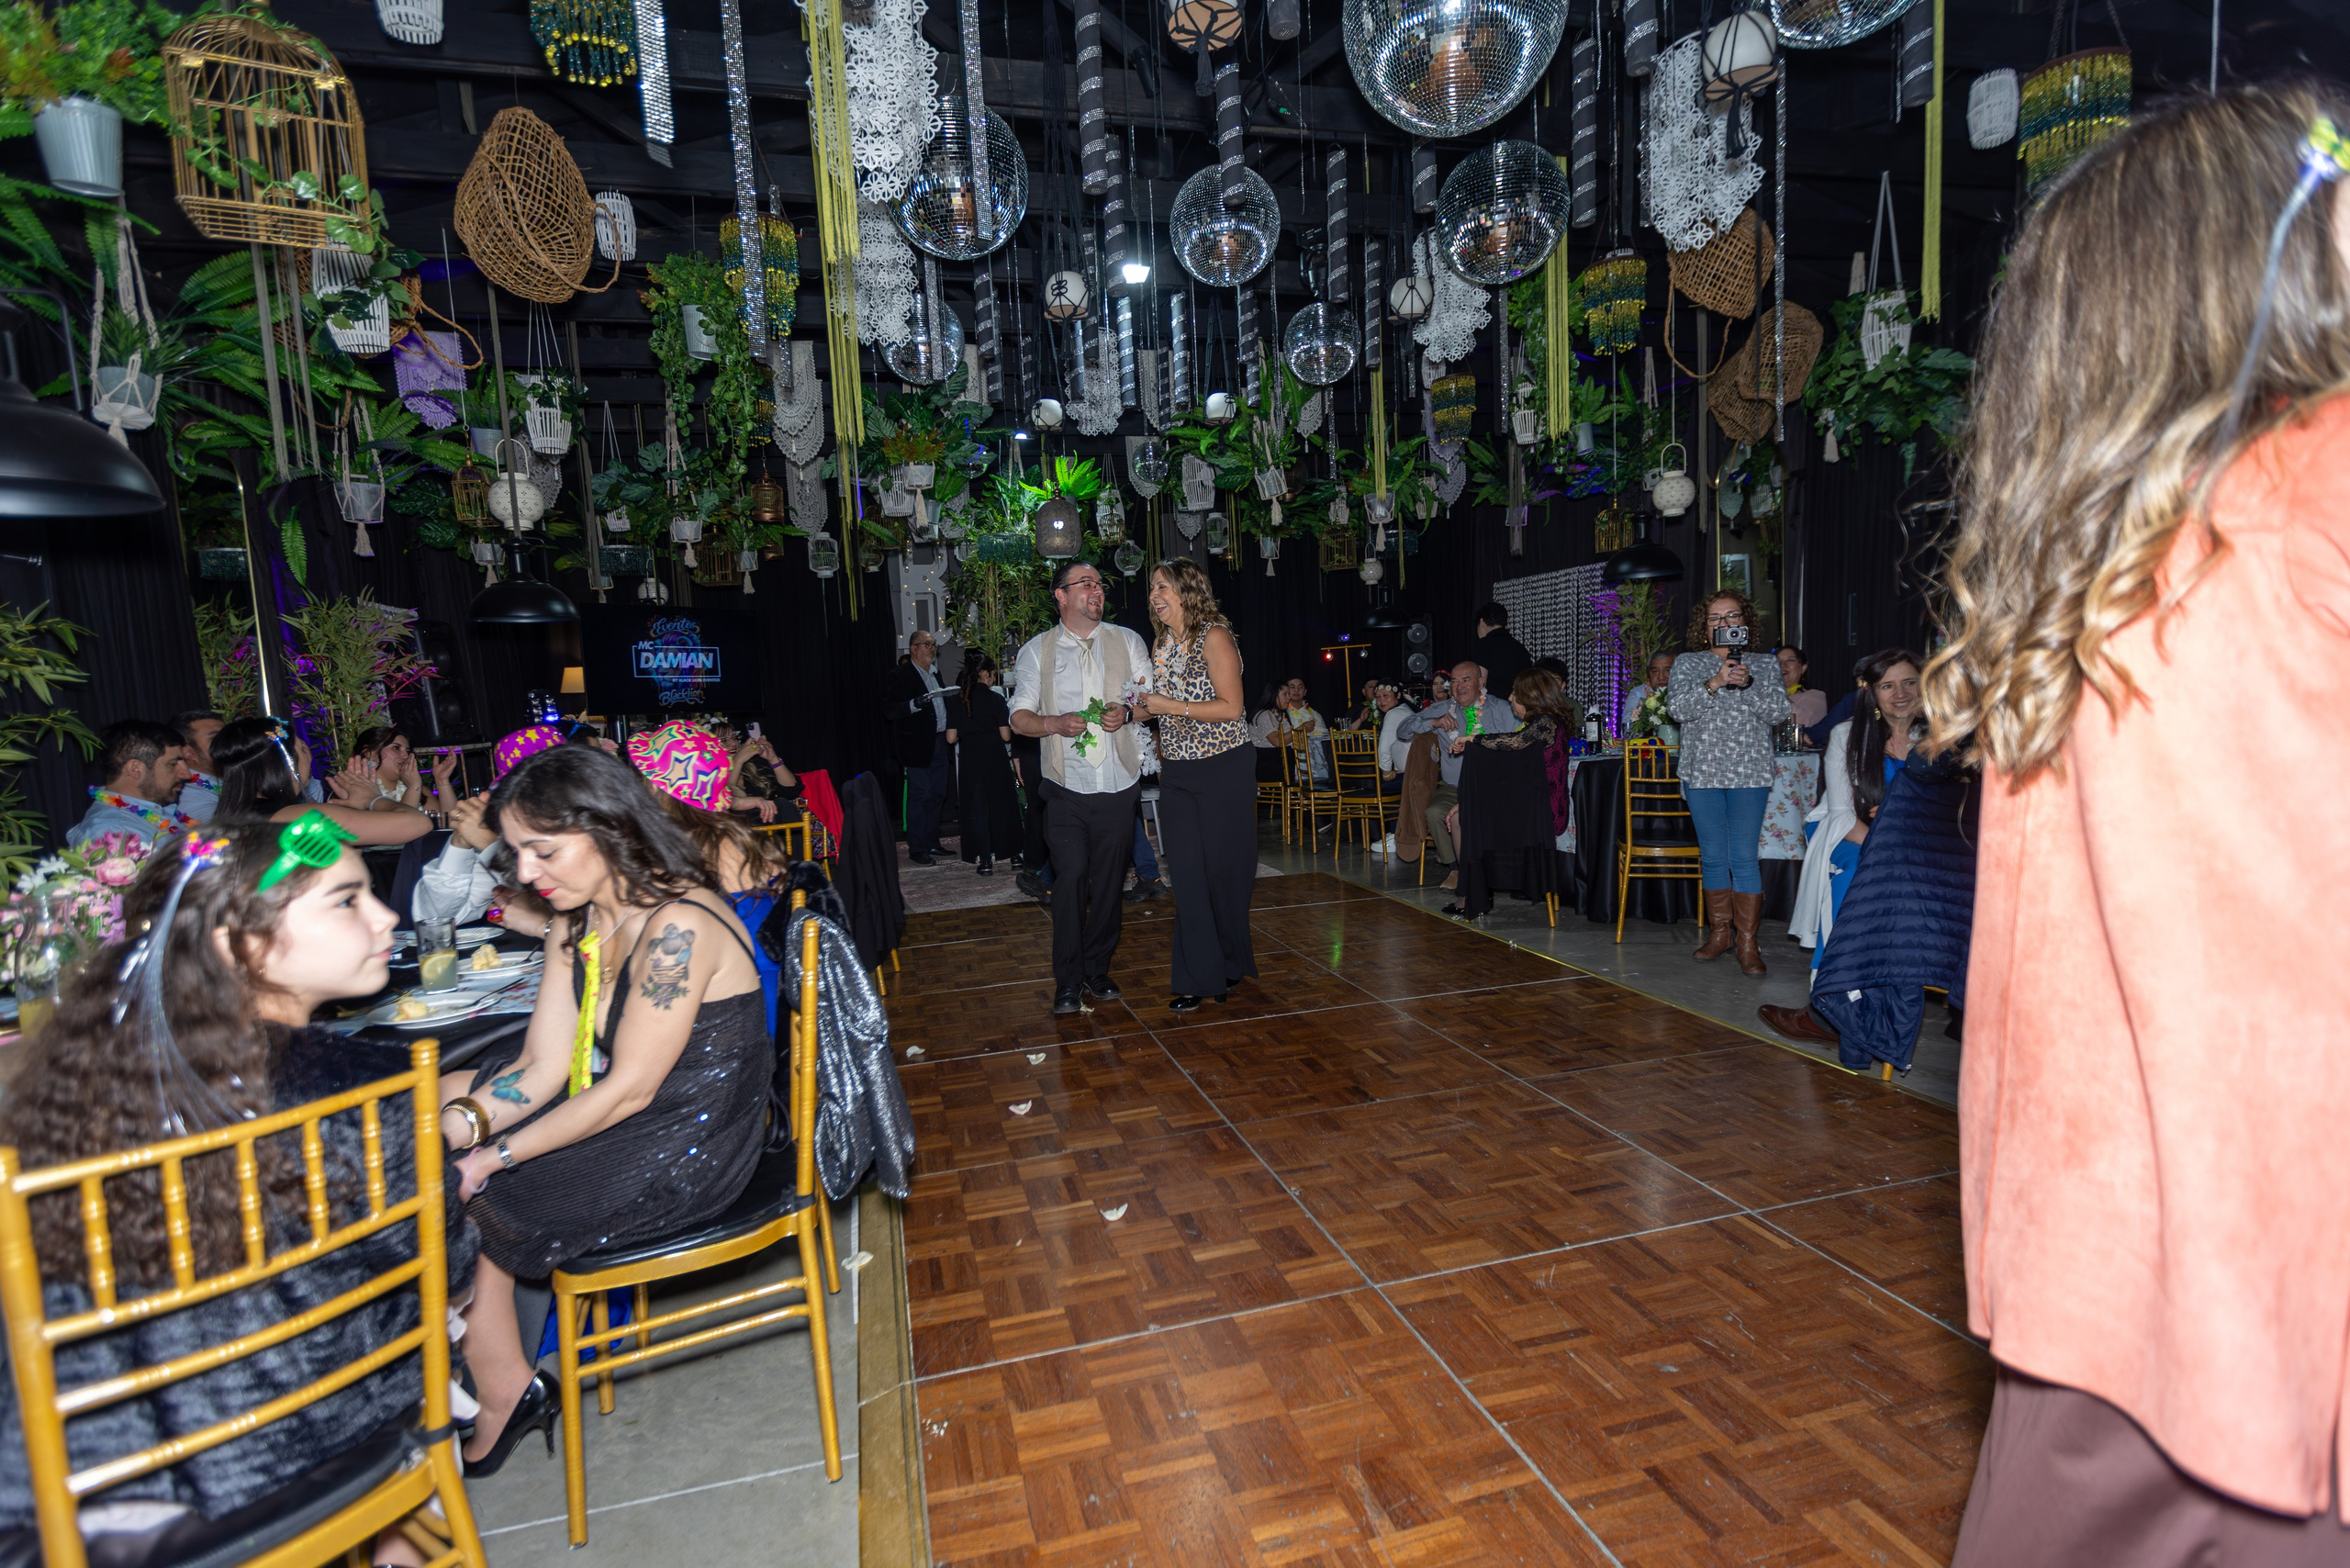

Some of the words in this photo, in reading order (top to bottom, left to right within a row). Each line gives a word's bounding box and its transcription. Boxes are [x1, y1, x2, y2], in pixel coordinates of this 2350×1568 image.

[652, 618, 699, 636] Eventos
[638, 641, 654, 650] MC
[640, 652, 713, 668] DAMIAN
